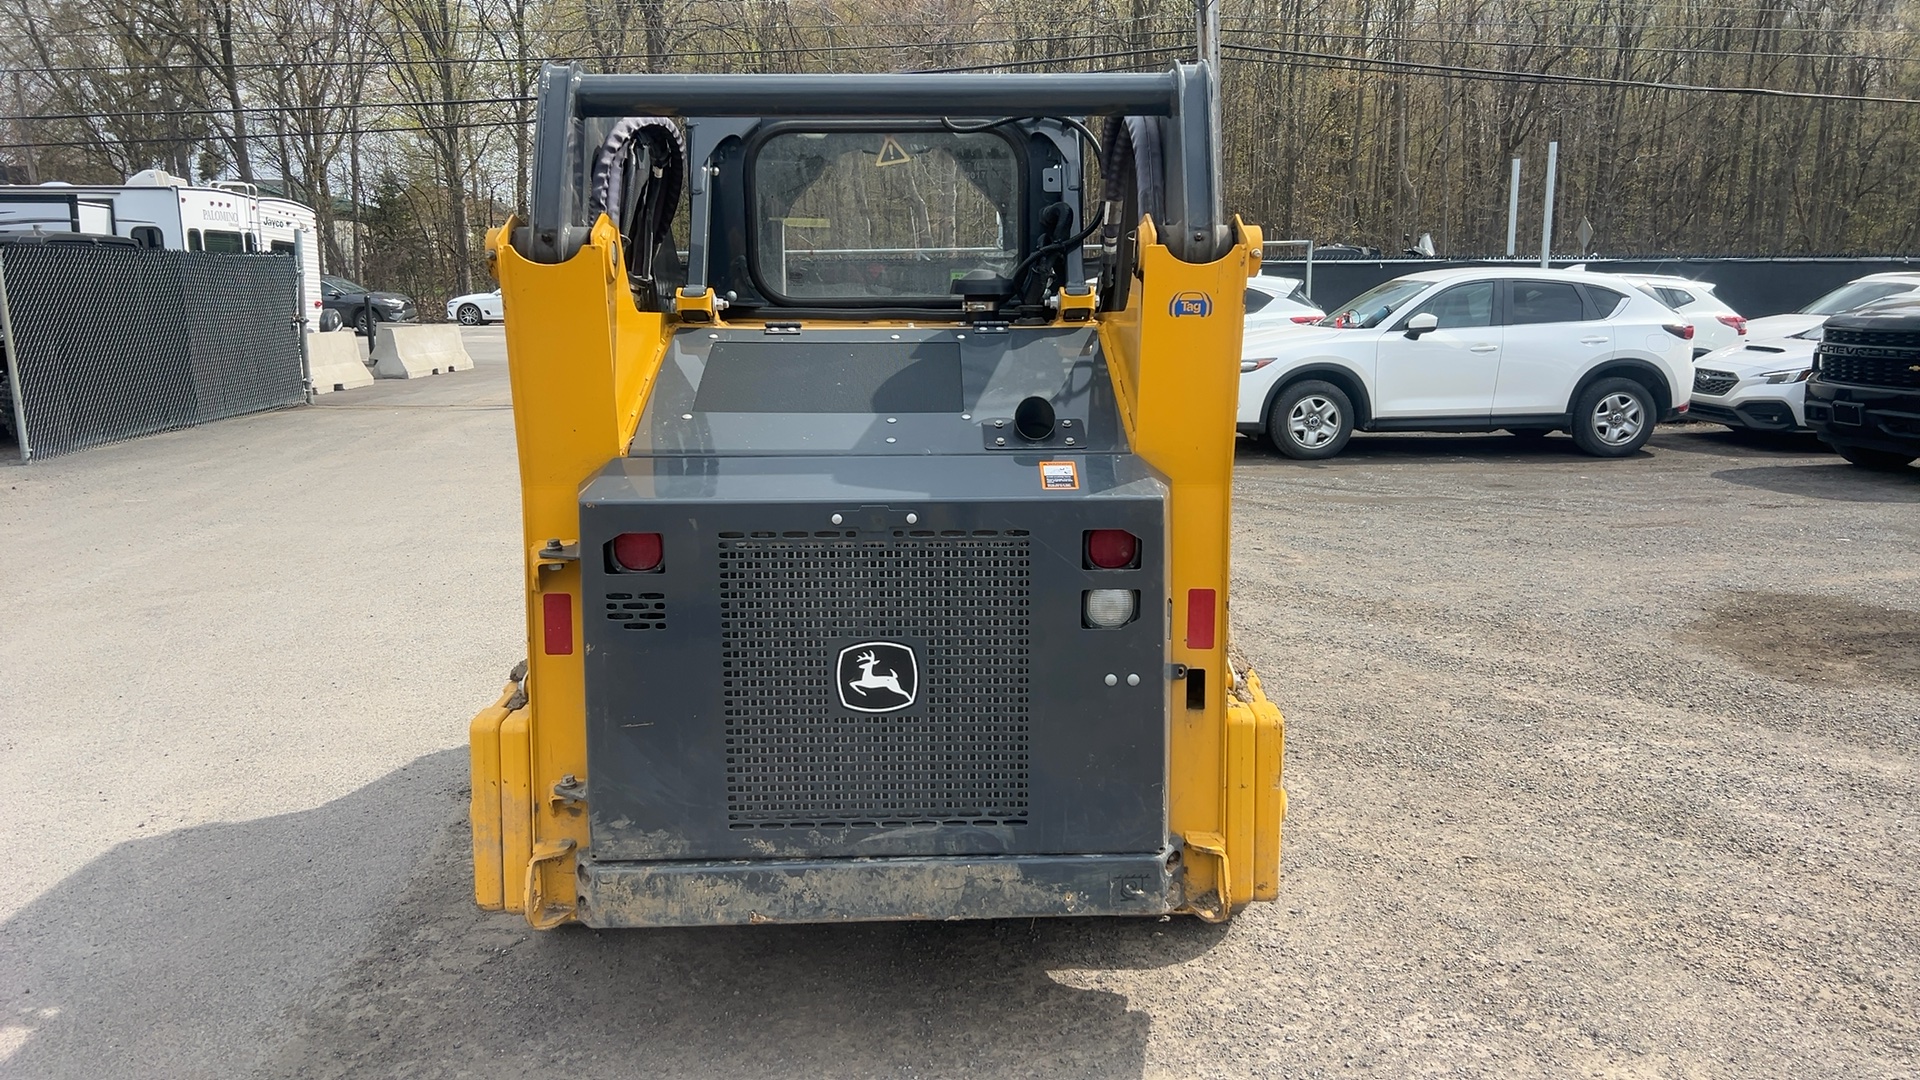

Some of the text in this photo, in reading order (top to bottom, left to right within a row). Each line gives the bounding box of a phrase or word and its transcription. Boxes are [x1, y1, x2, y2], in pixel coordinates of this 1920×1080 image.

[202, 209, 239, 222] PALOMINO
[263, 216, 284, 229] Jayco
[1181, 301, 1202, 314] Tag
